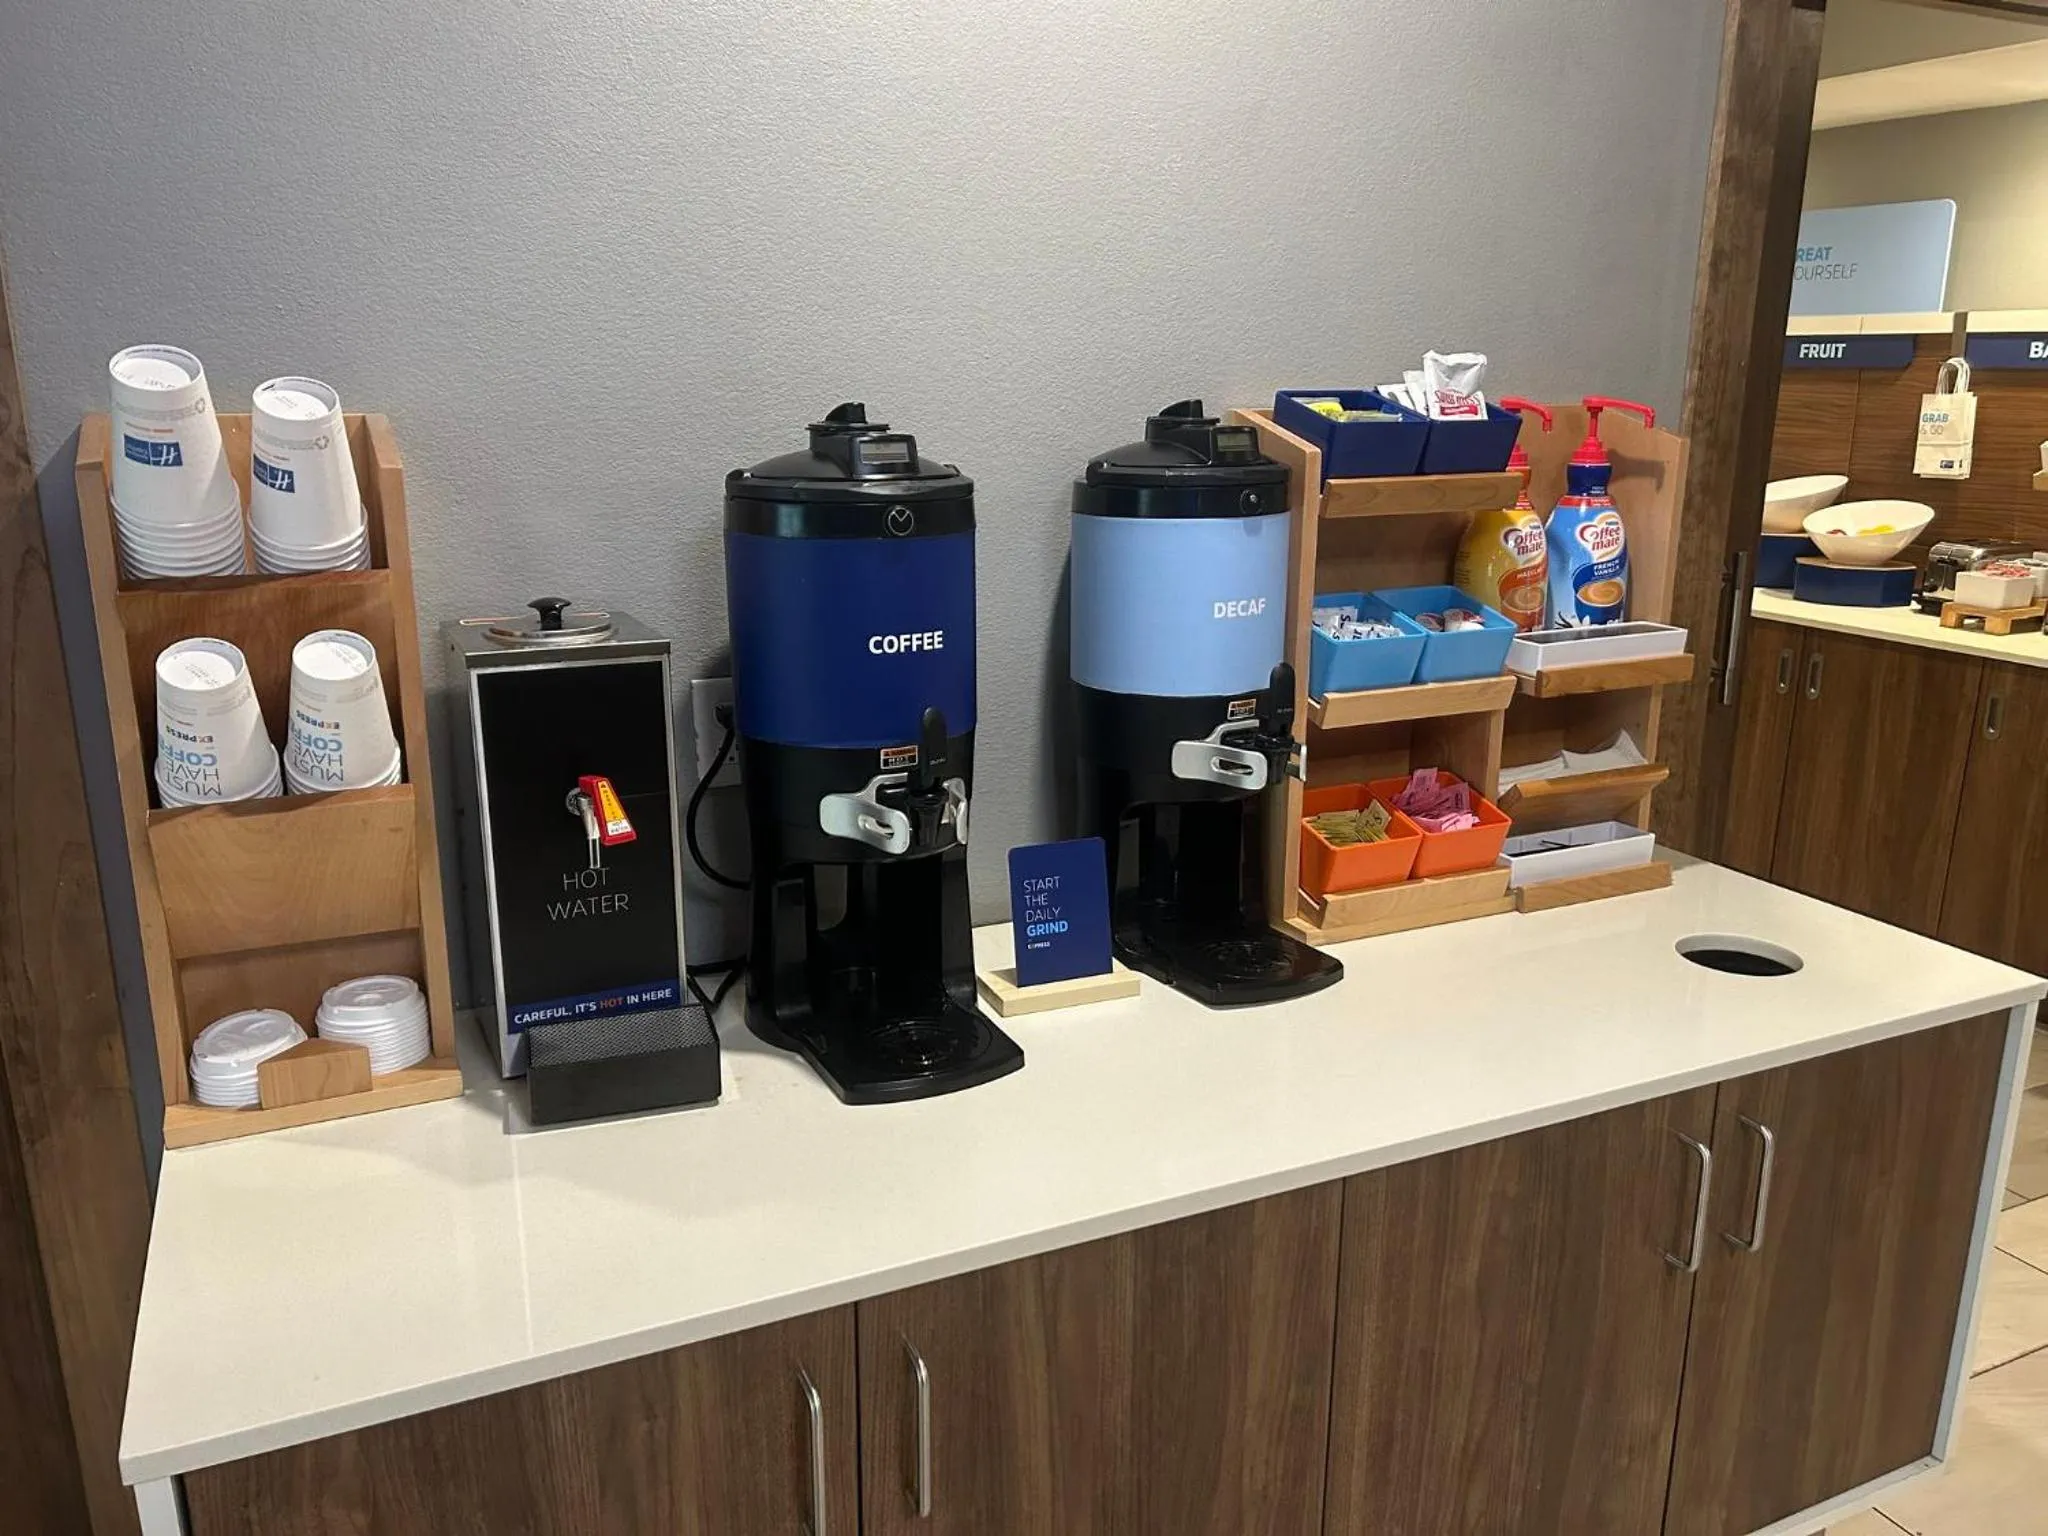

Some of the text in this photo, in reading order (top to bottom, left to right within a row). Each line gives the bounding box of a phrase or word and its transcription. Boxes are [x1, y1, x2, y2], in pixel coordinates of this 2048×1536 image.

[1799, 343, 1847, 358] FRUIT
[1922, 412, 1949, 423] GRAB
[1930, 424, 1944, 435] GO
[1579, 523, 1620, 543] Coffee
[1516, 541, 1543, 555] mate
[1592, 536, 1620, 551] mate
[1213, 597, 1267, 619] DECAF
[868, 630, 943, 655] COFFEE
[294, 742, 342, 767] HAVE
[164, 758, 220, 782] HAVE
[294, 754, 344, 781] MUST
[166, 771, 222, 796] MUST
[563, 867, 610, 891] HOT
[1023, 876, 1060, 893] START
[546, 893, 630, 920] WATER
[1024, 892, 1048, 907] THE
[1026, 907, 1061, 922] DAILY
[1026, 921, 1069, 937] GRIND
[514, 988, 673, 1024] CAREFUL. IT'S HOT IN HERE
